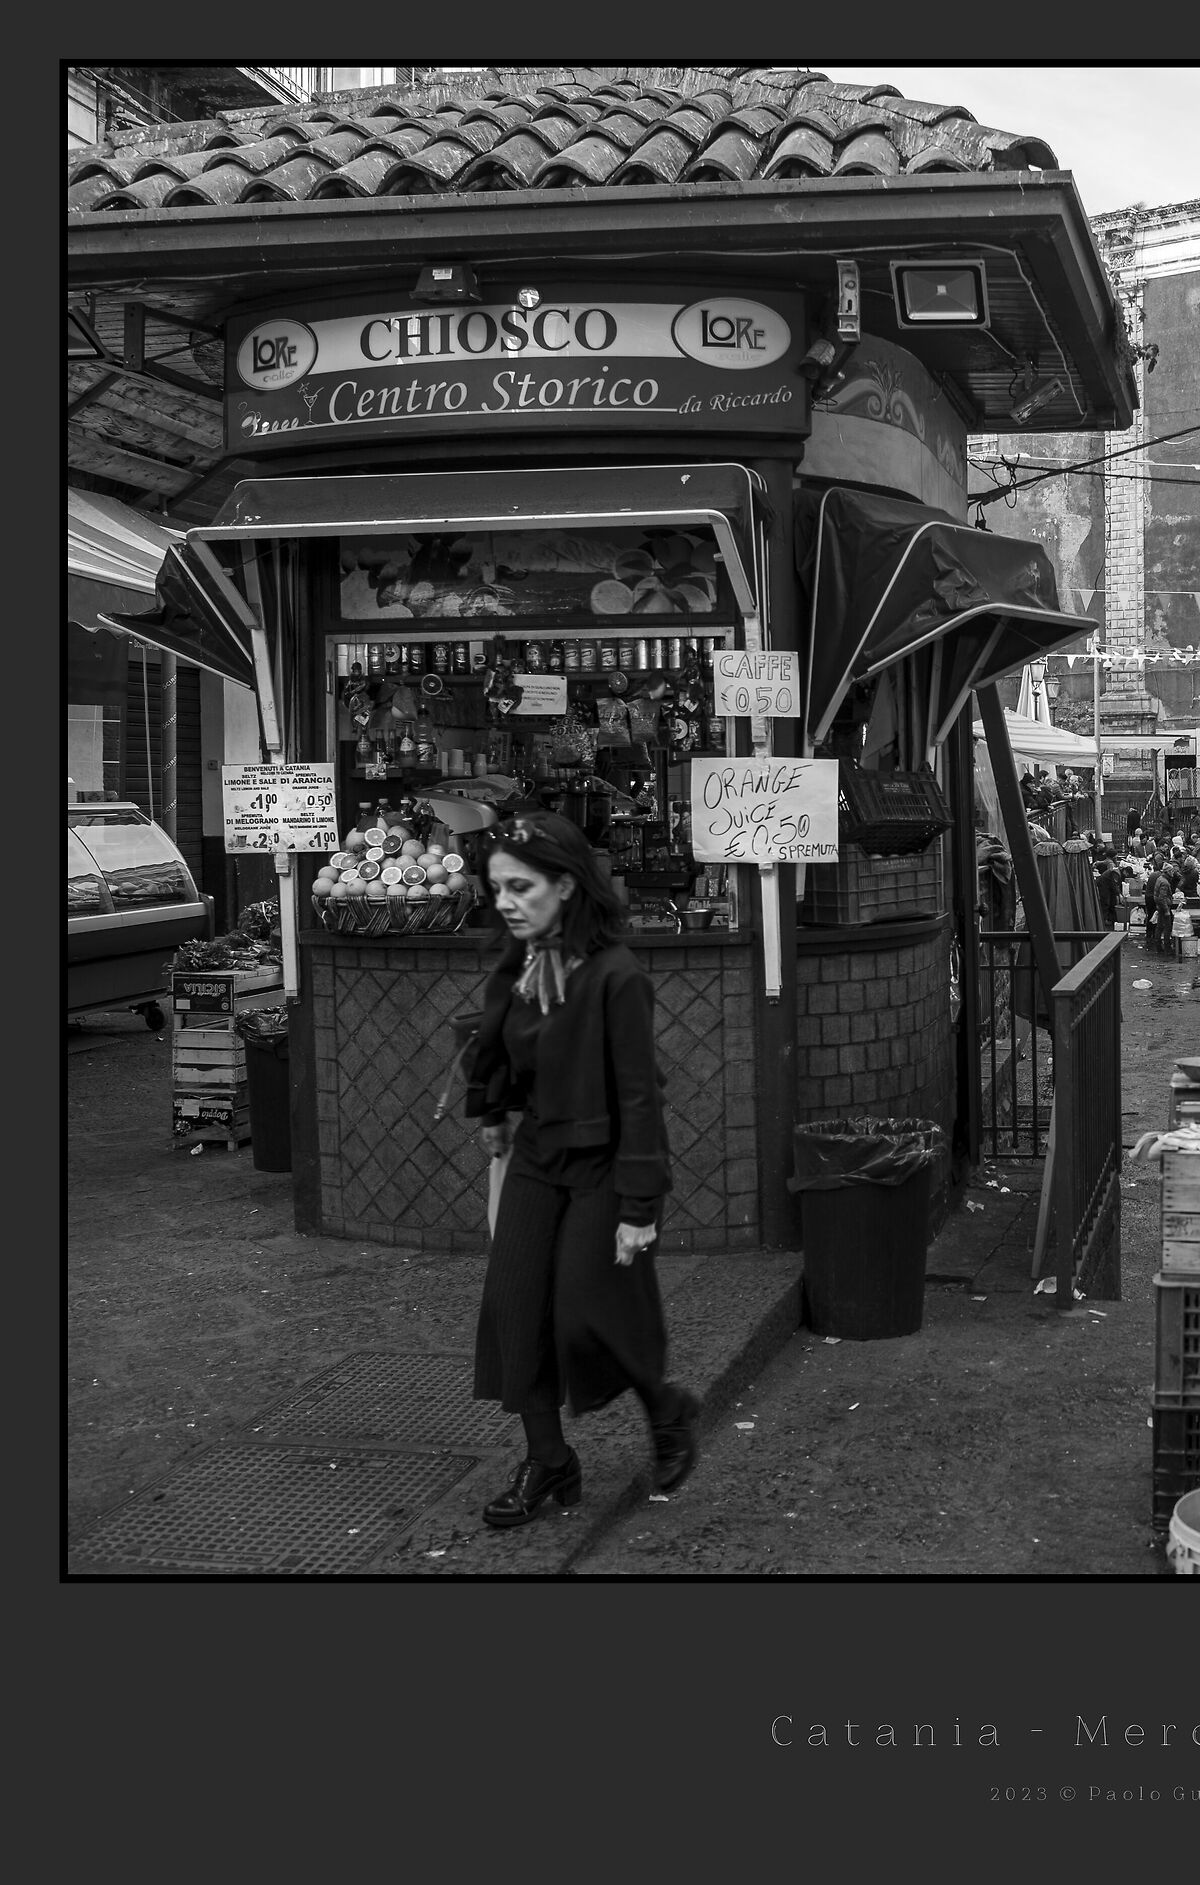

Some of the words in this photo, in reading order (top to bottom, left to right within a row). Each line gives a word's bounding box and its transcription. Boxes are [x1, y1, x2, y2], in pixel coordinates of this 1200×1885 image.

[360, 307, 618, 361] CHIOSCO
[701, 309, 767, 350] LORE
[252, 335, 298, 374] LORE
[328, 380, 469, 425] Centro
[481, 366, 660, 412] Storico
[679, 395, 702, 414] da
[709, 385, 793, 413] Riccardo
[719, 654, 792, 681] CAFFE
[703, 764, 814, 809] ORANGE
[235, 817, 279, 825] MELOGRANO
[778, 843, 839, 861] SPREMUTA
